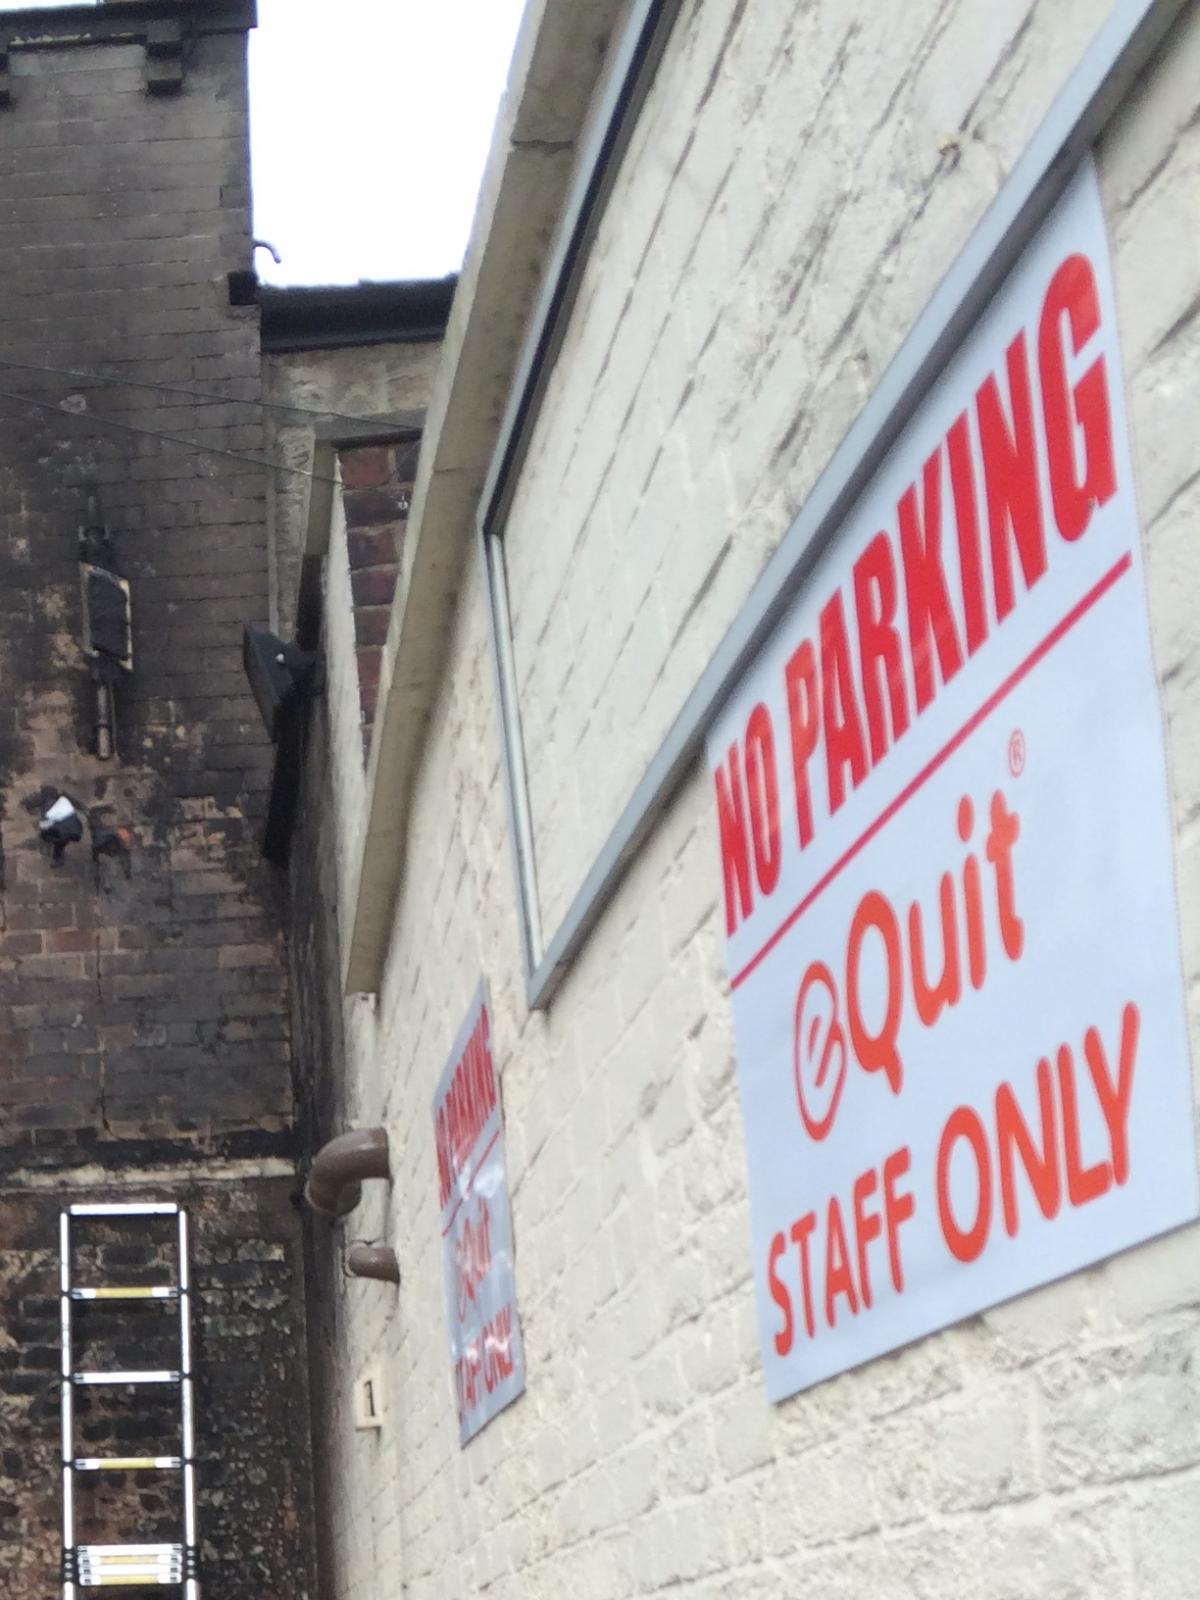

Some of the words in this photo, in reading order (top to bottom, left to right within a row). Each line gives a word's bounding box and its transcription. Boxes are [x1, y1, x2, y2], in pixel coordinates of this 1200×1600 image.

[713, 704, 782, 937] NO
[783, 253, 1117, 850] PARKING
[766, 1146, 915, 1357] STAFF
[934, 1002, 1141, 1264] ONLY
